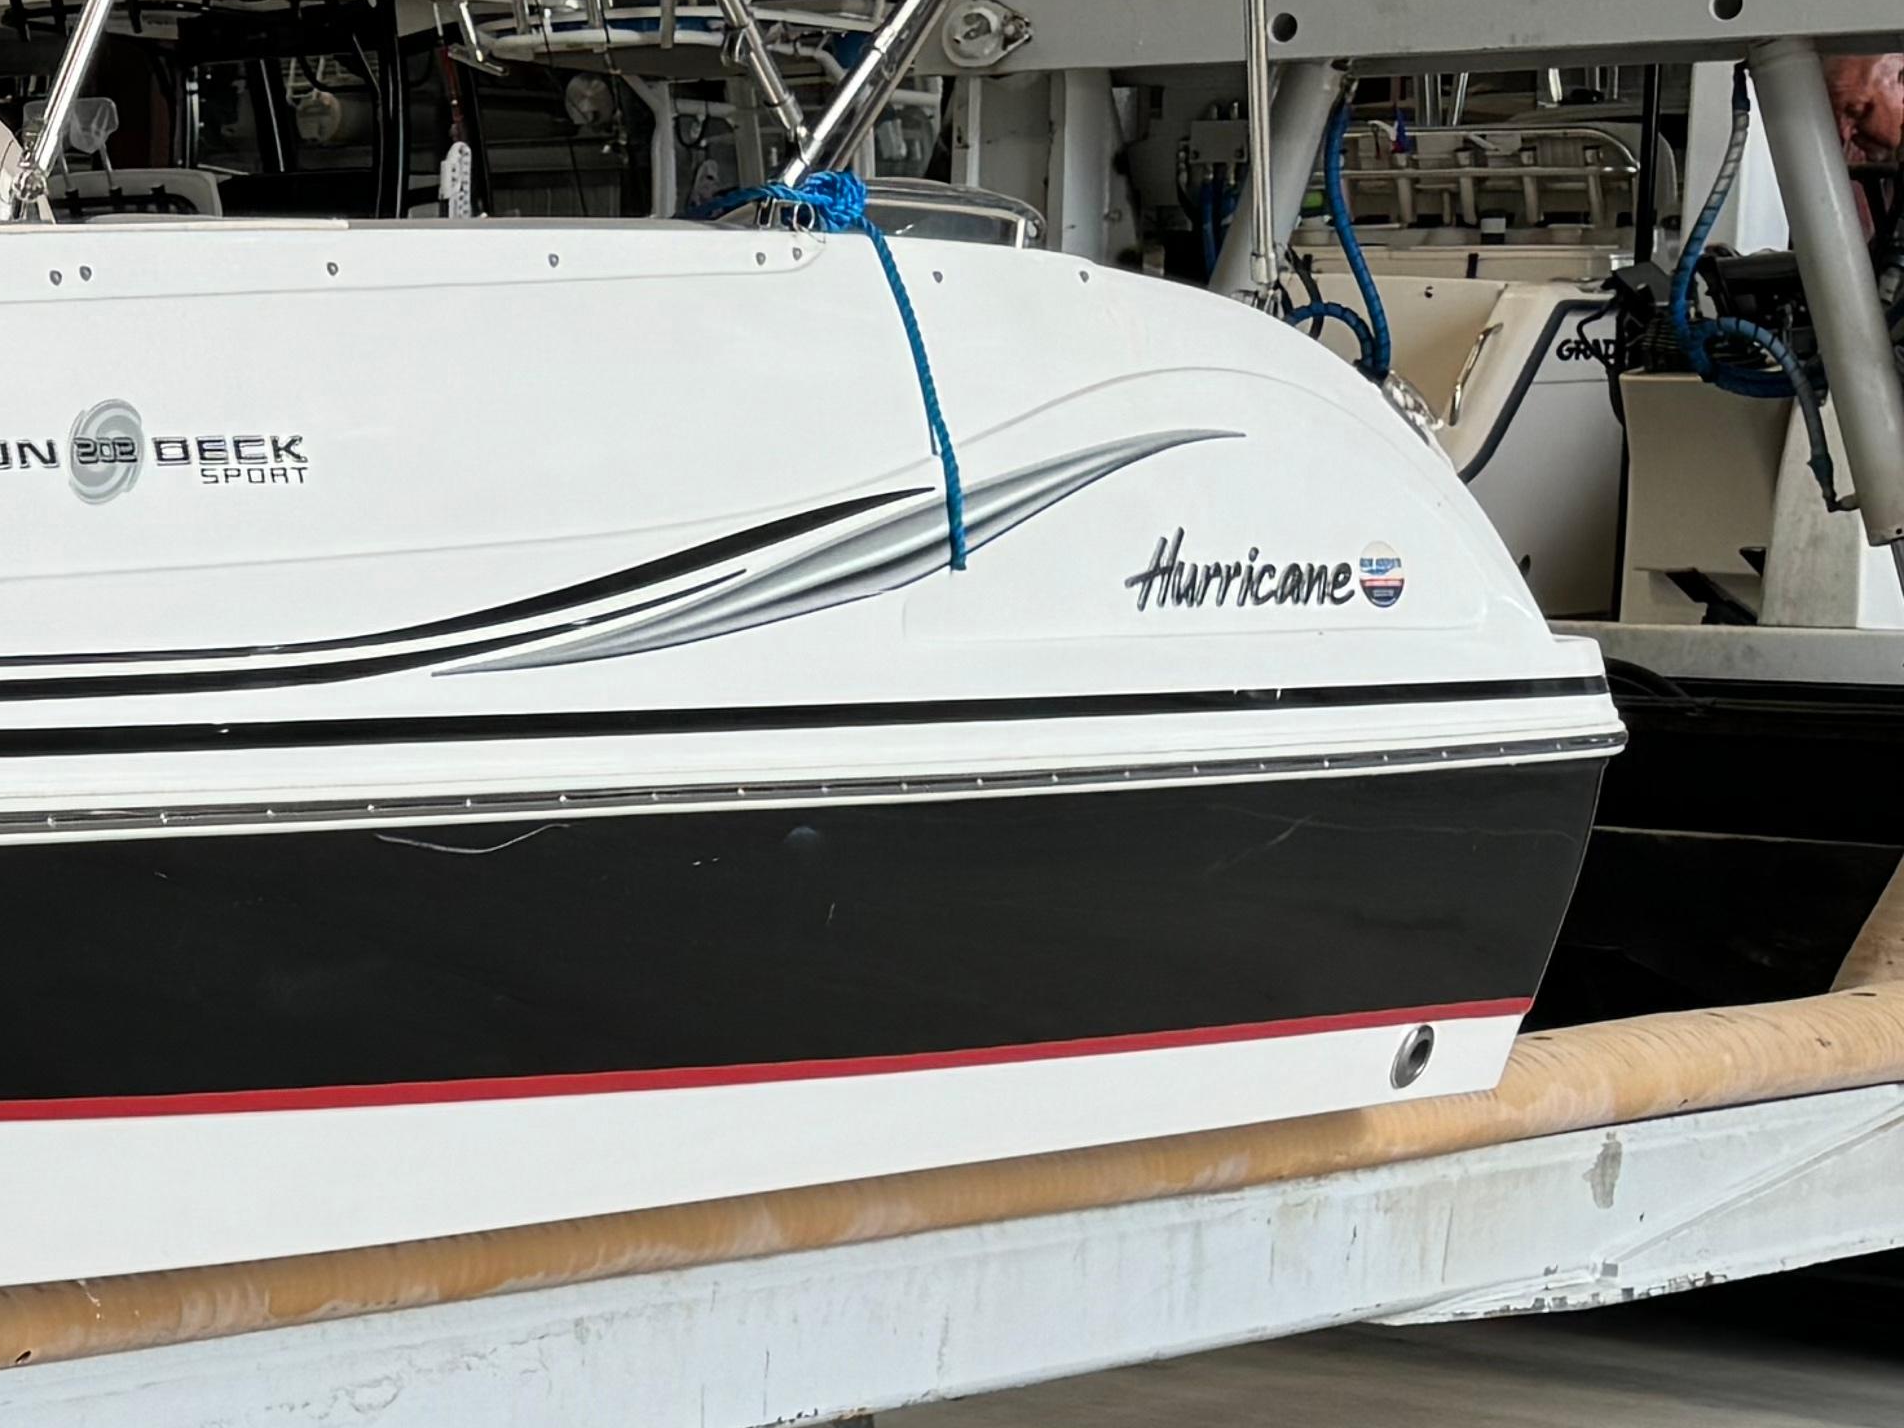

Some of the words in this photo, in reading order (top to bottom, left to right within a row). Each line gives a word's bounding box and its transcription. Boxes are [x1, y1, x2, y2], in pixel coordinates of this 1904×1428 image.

[74, 436, 138, 465] 202
[151, 434, 309, 467] DECK
[200, 466, 309, 486] SPORT
[1124, 526, 1356, 612] Hurricane
